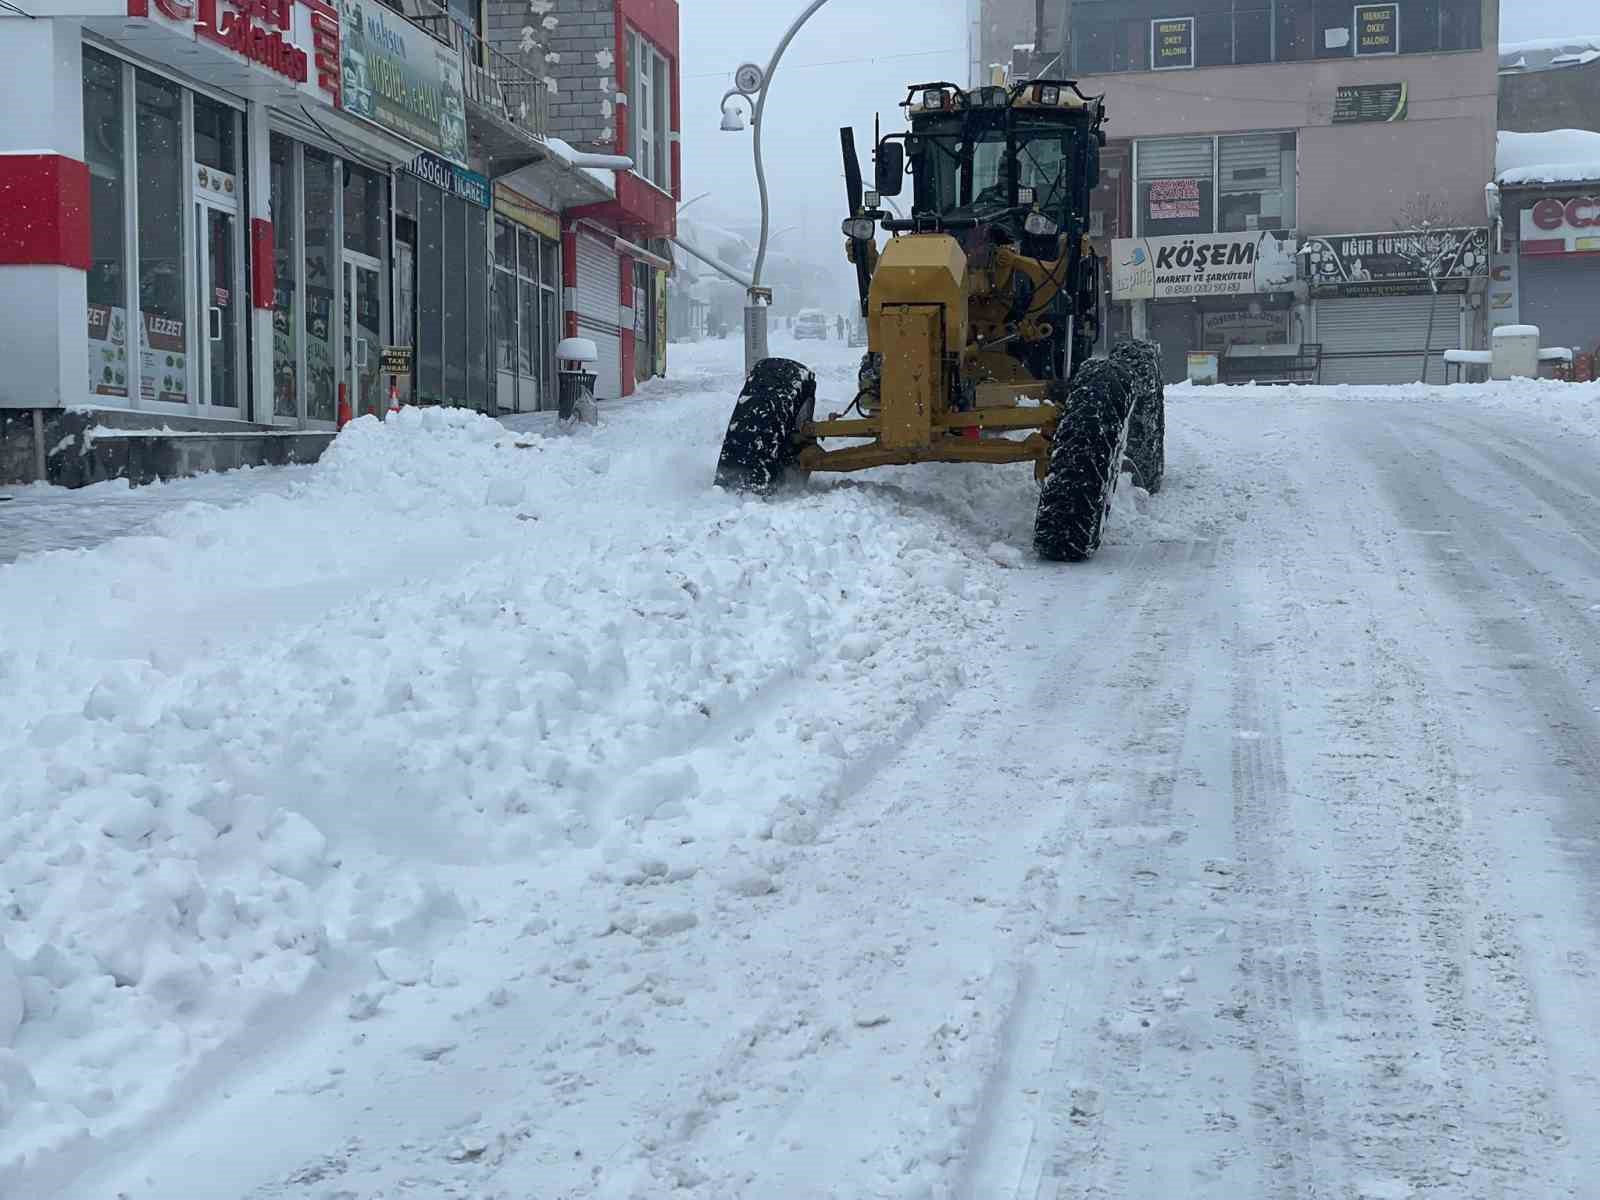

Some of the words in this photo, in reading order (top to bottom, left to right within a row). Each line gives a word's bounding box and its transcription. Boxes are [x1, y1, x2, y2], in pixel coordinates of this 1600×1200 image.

[1155, 239, 1255, 273] KÖŞEM
[1342, 237, 1373, 256] UĞUR
[1156, 274, 1191, 284] MARKET
[1193, 273, 1204, 282] VE
[149, 316, 183, 337] LEZZET
